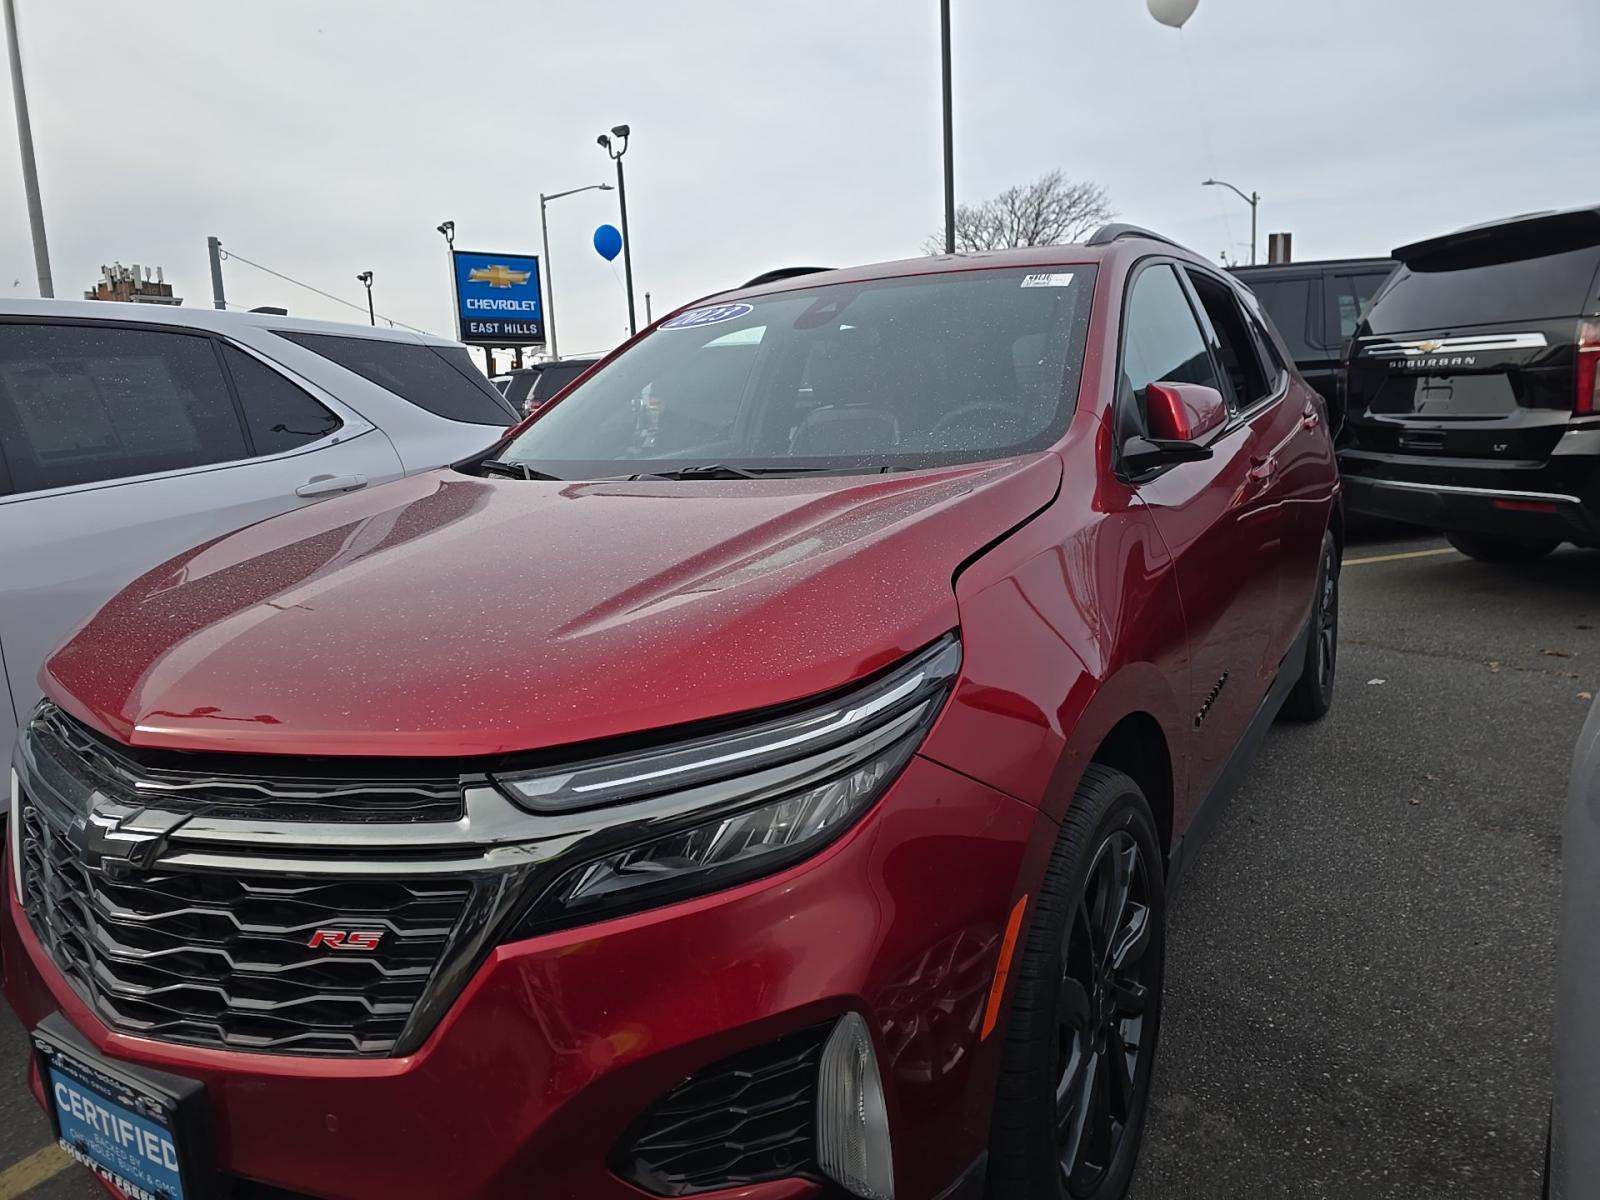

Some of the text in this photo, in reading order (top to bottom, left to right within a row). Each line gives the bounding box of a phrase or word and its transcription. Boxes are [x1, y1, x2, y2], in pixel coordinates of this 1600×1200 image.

[466, 298, 536, 311] CHEVROLET
[470, 322, 537, 334] EAST HILLS
[1389, 356, 1476, 368] SUBURBAN
[1493, 444, 1508, 452] LT
[307, 930, 384, 950] RS
[54, 1082, 179, 1172] CERTIFIED
[129, 1154, 141, 1166] BY
